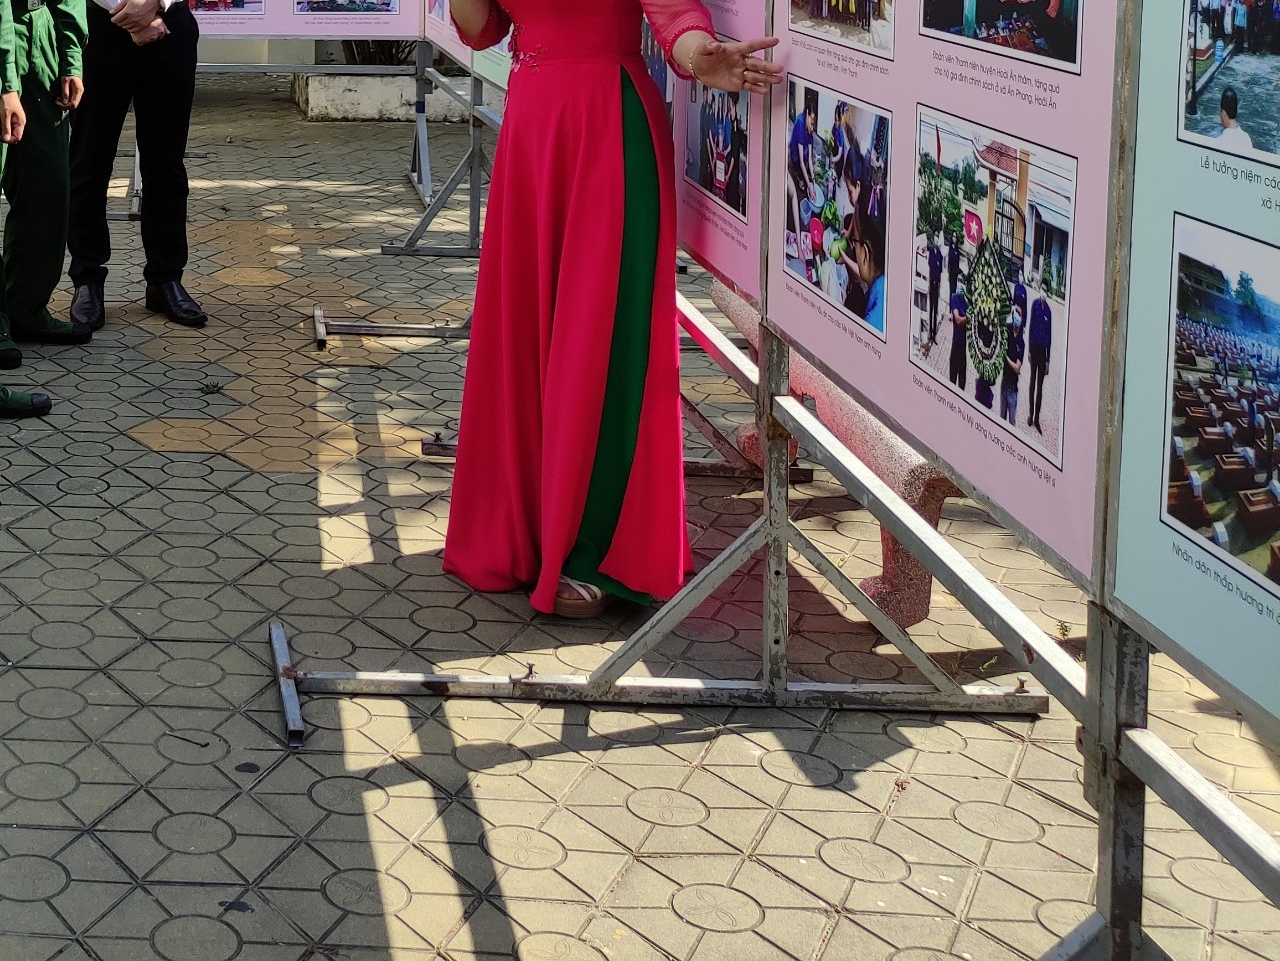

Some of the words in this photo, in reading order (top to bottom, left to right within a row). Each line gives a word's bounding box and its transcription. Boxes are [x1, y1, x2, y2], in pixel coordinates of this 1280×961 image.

[932, 50, 944, 61] Đoàn
[945, 54, 955, 63] viên
[955, 56, 968, 69] Thanh
[969, 62, 979, 72] niên
[980, 64, 996, 77] huyện
[997, 67, 1008, 79] Hoài
[1034, 79, 1047, 93] tặng
[1048, 82, 1060, 94] quà
[1200, 156, 1210, 169] Lễ
[1212, 160, 1238, 180] tưởng
[1241, 169, 1261, 184] niệm
[1261, 198, 1272, 209] xã
[1172, 541, 1193, 566] Nhân
[1195, 559, 1212, 578] dân
[1213, 569, 1233, 592] thắp
[1236, 583, 1264, 615] hương
[1266, 603, 1274, 620] tri
